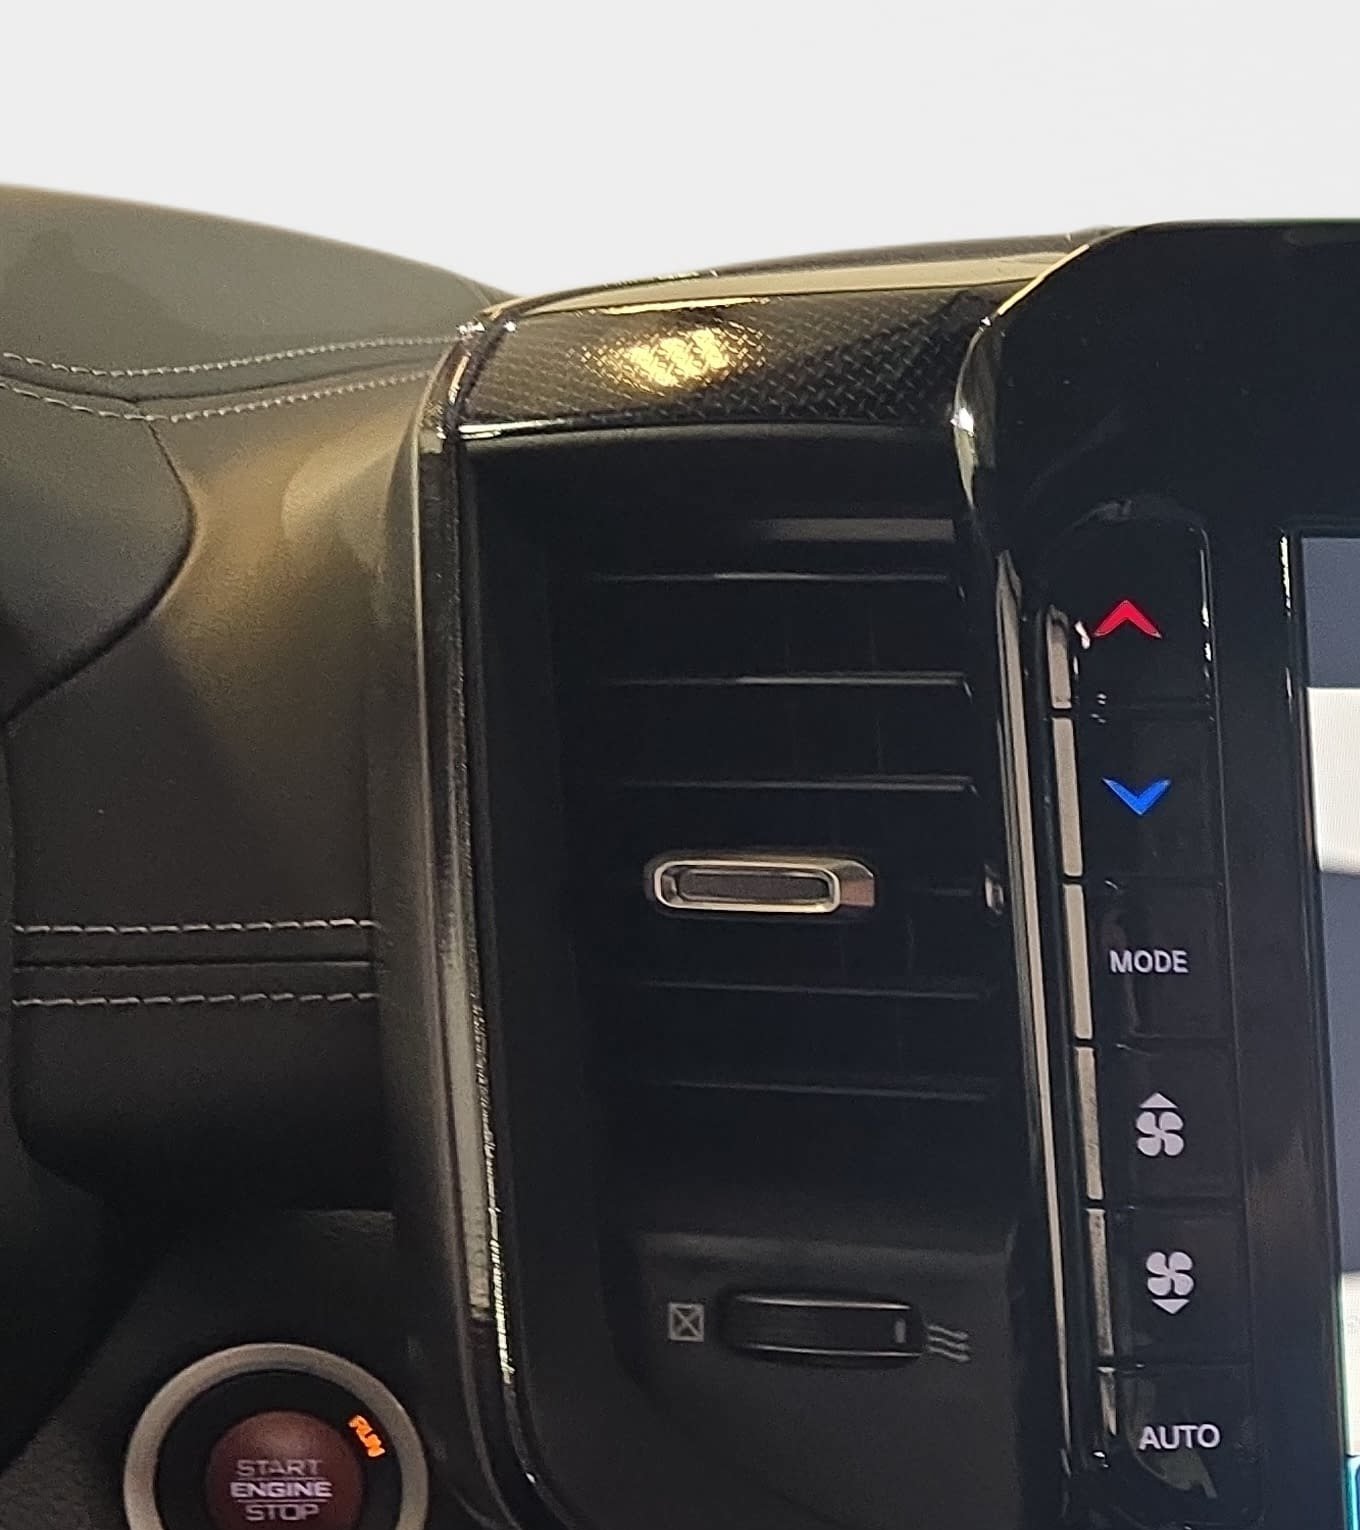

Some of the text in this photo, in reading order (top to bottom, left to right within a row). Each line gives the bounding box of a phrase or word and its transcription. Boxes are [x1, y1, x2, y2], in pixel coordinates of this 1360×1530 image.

[1110, 949, 1188, 976] MODE
[1139, 1423, 1221, 1451] AUTO
[236, 1459, 320, 1477] START
[230, 1481, 333, 1497] ENGINE
[245, 1503, 319, 1520] STOP
